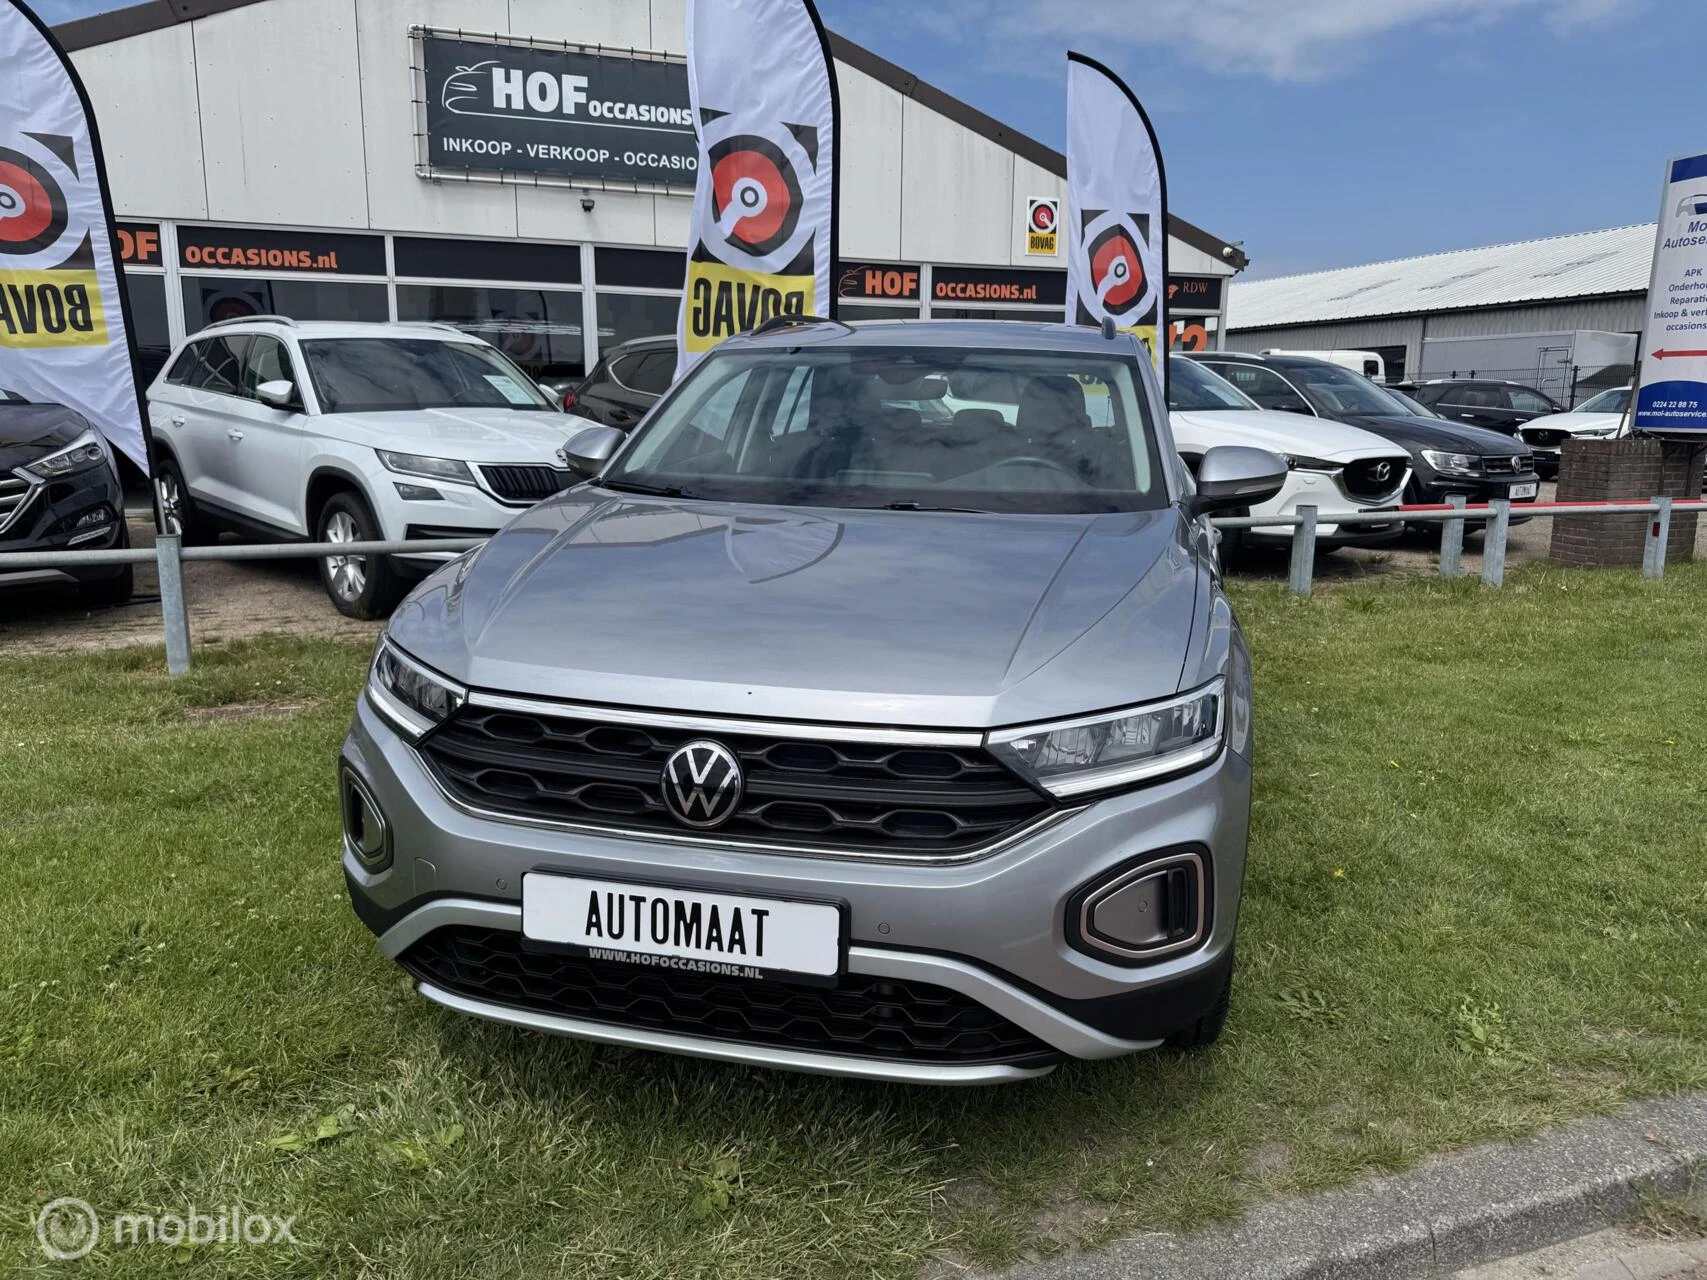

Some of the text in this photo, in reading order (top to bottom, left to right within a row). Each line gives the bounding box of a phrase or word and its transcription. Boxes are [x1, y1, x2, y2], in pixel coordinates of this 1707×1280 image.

[492, 67, 693, 125] HOF OCCASIONS
[443, 137, 512, 155] INKOOP
[526, 143, 610, 163] VERKOOP
[1030, 236, 1054, 250] BOVAG
[1662, 235, 1707, 250] Autose
[185, 245, 338, 270] OCCASIONS.nl
[1684, 268, 1703, 278] APK
[864, 270, 918, 296] HOF
[936, 282, 1037, 300] OCCASIONS.nl
[1183, 281, 1208, 294] RDW
[1668, 282, 1707, 293] Onderho
[1654, 311, 1679, 319] Inkoop
[1680, 309, 1688, 317] &
[585, 890, 770, 957] AUTOMAAT
[589, 948, 764, 980] WWW.HOFOCCASIONS.NL
